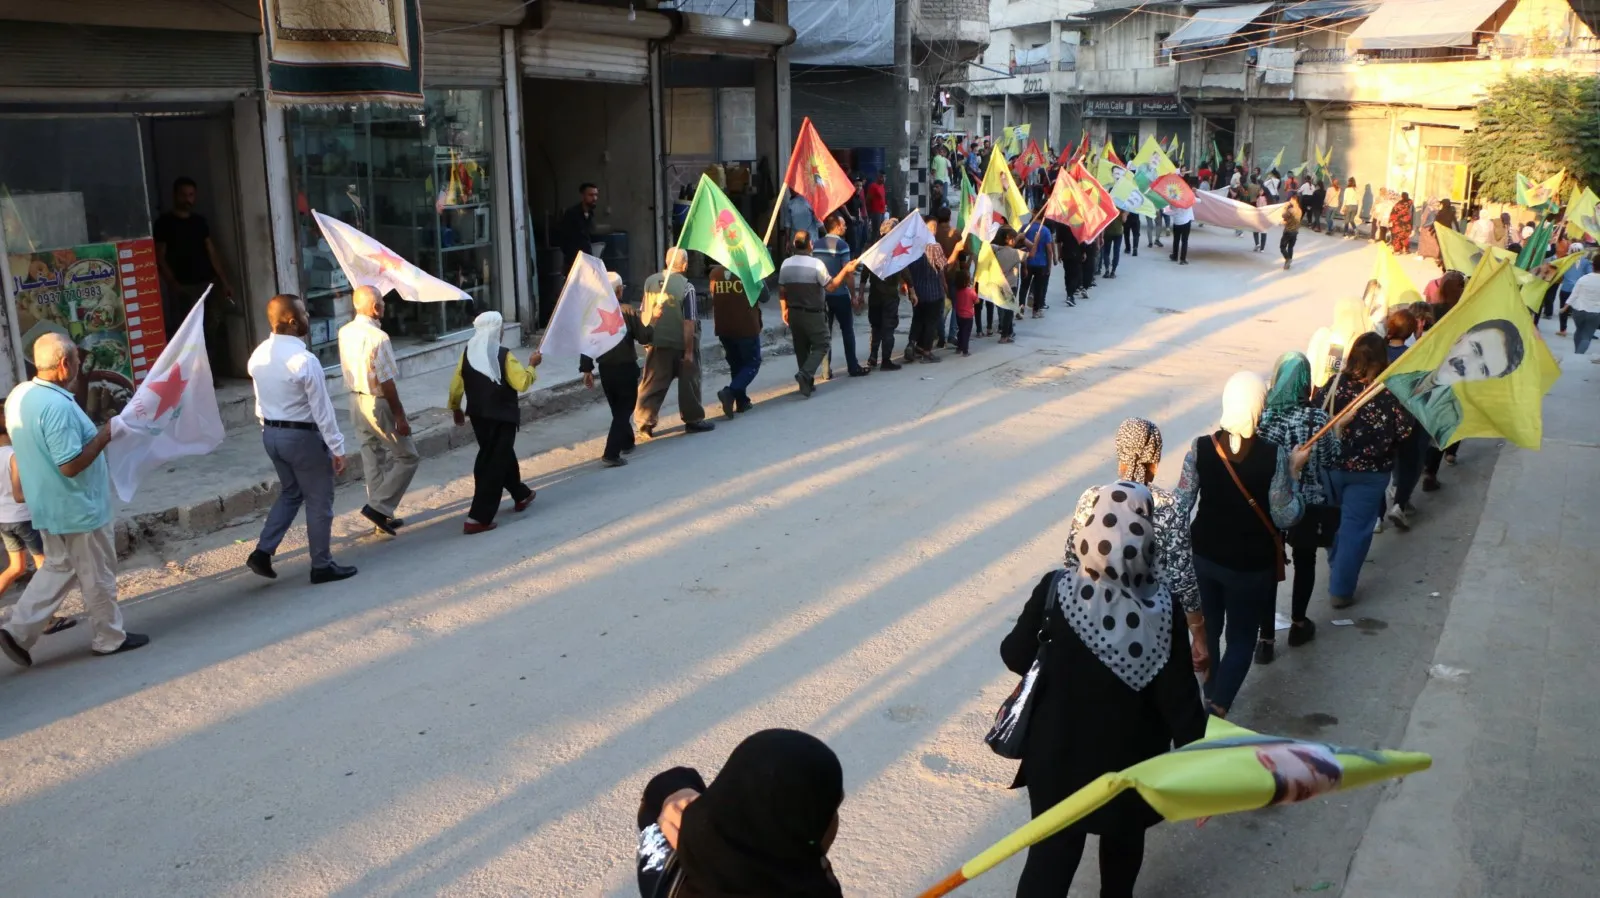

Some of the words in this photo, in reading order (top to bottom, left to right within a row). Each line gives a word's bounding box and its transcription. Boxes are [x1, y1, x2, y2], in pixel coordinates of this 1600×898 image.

[1095, 101, 1110, 109] Afrin
[1111, 101, 1124, 110] Cafe
[69, 268, 115, 284] مطعم
[84, 285, 101, 298] 983
[715, 280, 743, 294] HPC
